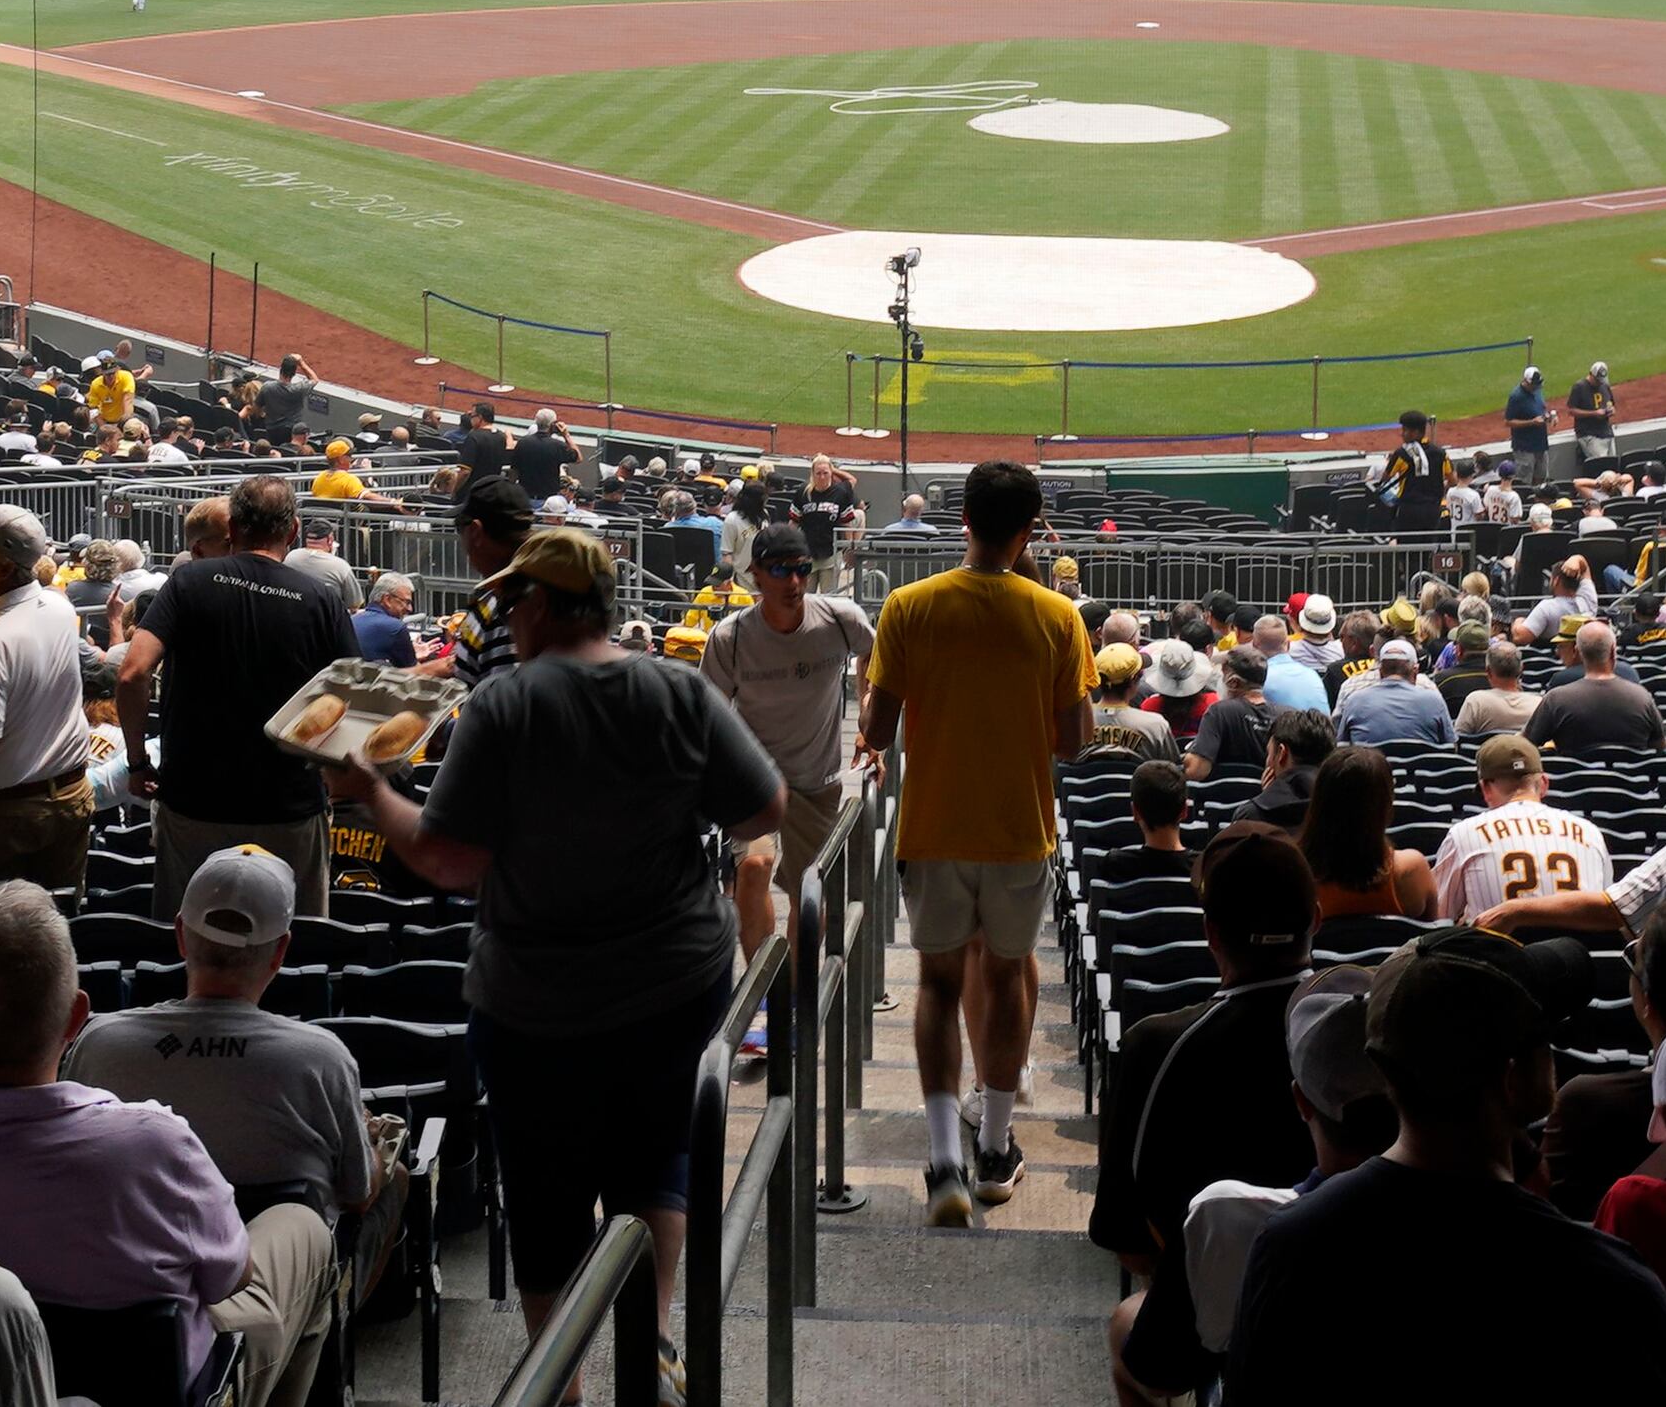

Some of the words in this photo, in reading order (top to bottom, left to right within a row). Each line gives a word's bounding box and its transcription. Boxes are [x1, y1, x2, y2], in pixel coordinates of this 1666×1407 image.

[1593, 392, 1603, 409] P
[113, 504, 125, 514] 17
[609, 544, 622, 554] 17
[1441, 556, 1455, 568] 16
[1477, 816, 1552, 845] TATIS
[1559, 822, 1591, 849] JR.
[1502, 850, 1581, 900] 23
[186, 1035, 247, 1058] AHN
